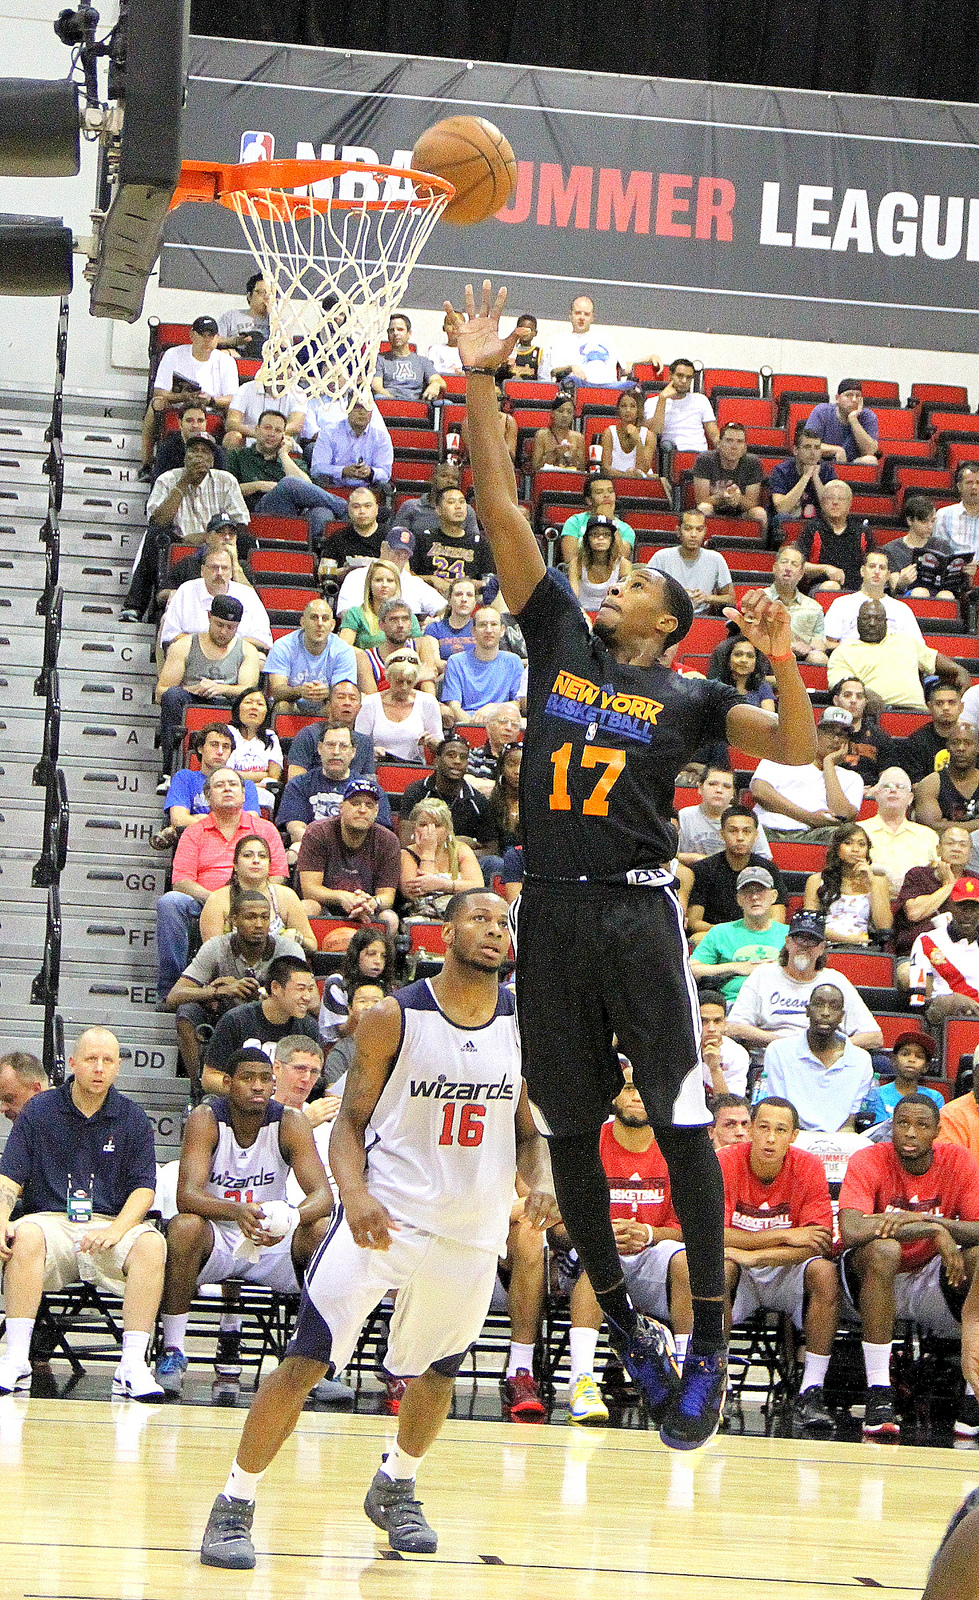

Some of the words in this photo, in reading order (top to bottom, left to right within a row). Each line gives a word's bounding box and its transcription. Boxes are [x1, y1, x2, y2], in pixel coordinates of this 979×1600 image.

[494, 161, 736, 242] UMMER
[104, 407, 113, 418] K
[116, 438, 126, 450] J
[119, 471, 130, 482] H
[117, 502, 129, 515] G
[120, 535, 130, 547] F
[432, 556, 466, 579] 24
[119, 572, 129, 585] E
[121, 648, 133, 662] C
[122, 688, 134, 701] B
[552, 669, 600, 705] NEW
[600, 691, 664, 725] YORK
[546, 693, 653, 739] BASKETBALL
[126, 730, 139, 745] A
[117, 777, 139, 793] JJ
[549, 742, 626, 817] 17
[125, 823, 153, 839] HH
[126, 873, 156, 892] GG
[129, 929, 156, 947] FF
[130, 987, 157, 1005] EE
[134, 1050, 165, 1068] DD
[410, 1073, 514, 1101] wizards
[439, 1102, 487, 1148] 16
[209, 1167, 276, 1188] wizards
[732, 1211, 792, 1229] BASKETBALL
